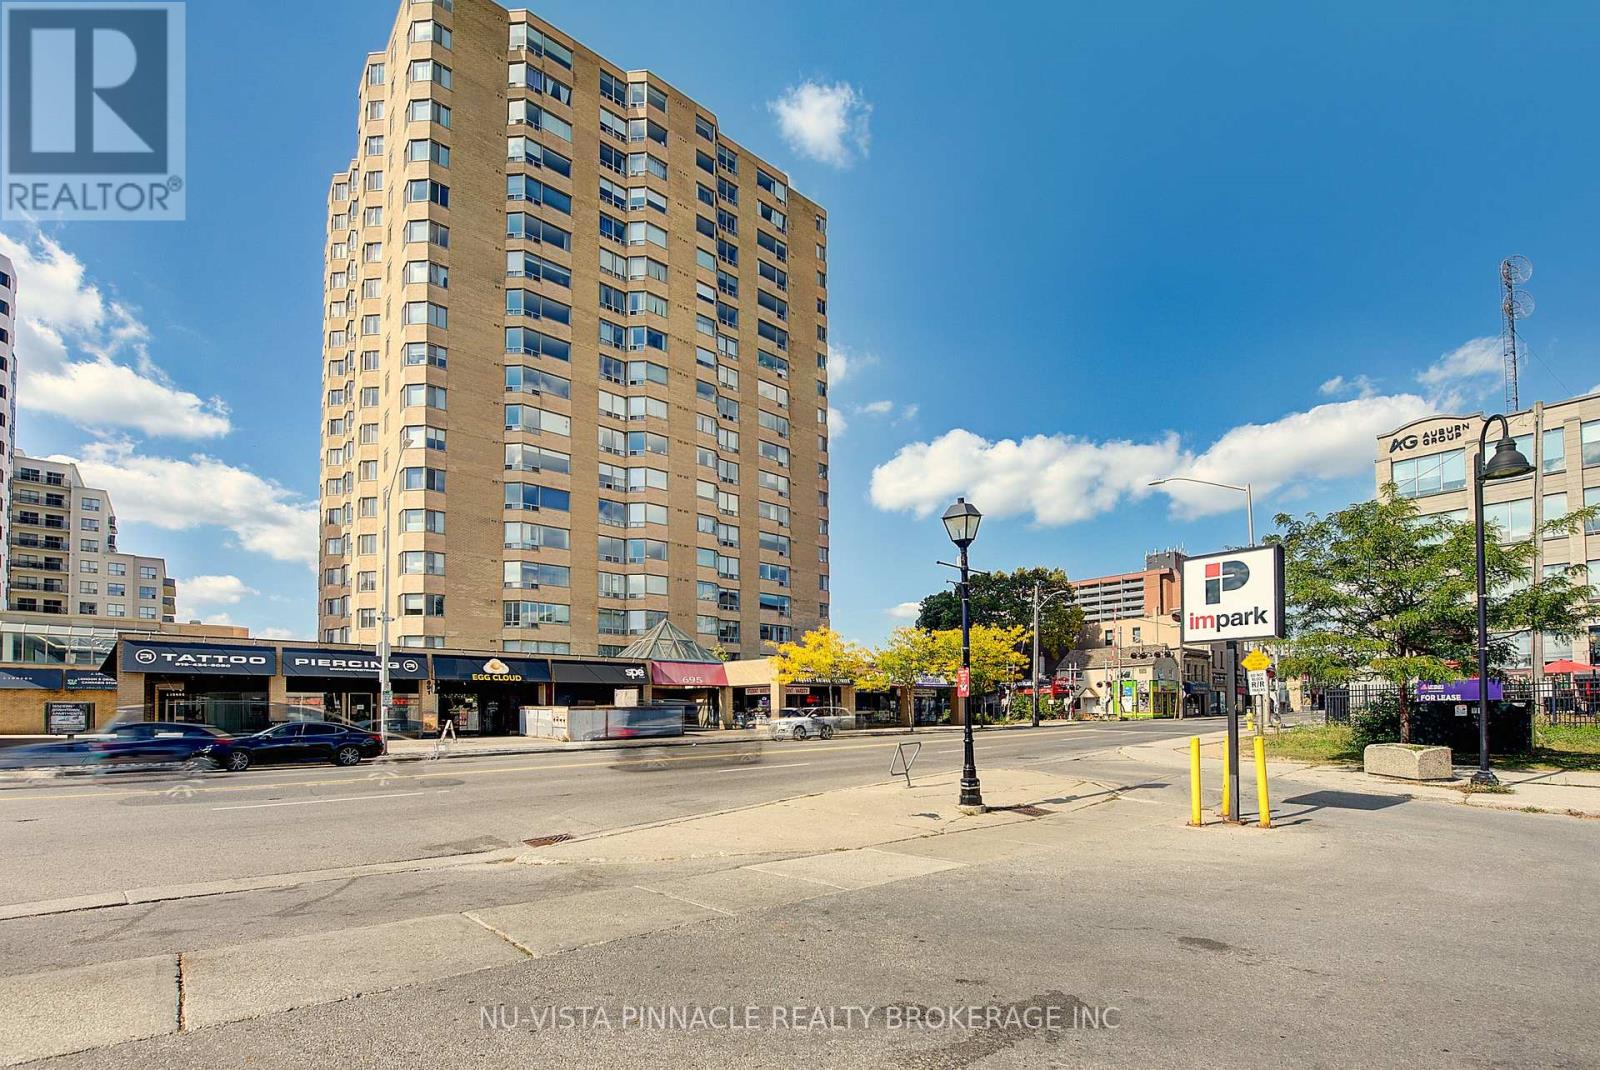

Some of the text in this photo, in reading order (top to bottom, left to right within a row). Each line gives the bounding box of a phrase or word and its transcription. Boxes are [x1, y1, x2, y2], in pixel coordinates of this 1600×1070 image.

[1422, 423, 1469, 439] AUBURN
[1422, 432, 1462, 446] GROUP
[1189, 606, 1269, 633] impark
[161, 653, 267, 665] TATTOO
[294, 657, 400, 669] PIERCING
[472, 673, 522, 682] EGG CLOUD
[682, 676, 703, 684] 695
